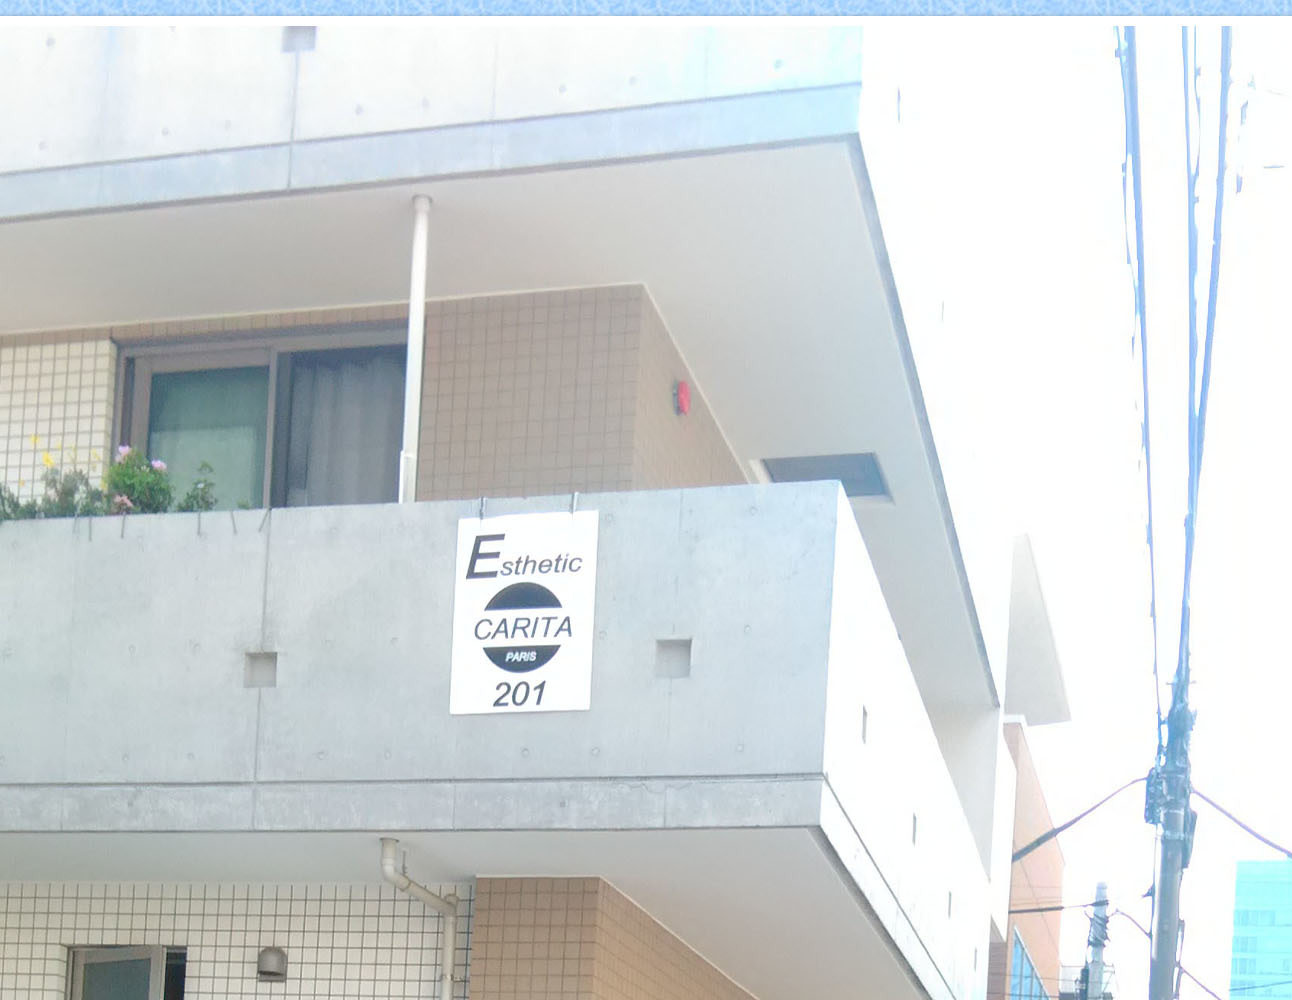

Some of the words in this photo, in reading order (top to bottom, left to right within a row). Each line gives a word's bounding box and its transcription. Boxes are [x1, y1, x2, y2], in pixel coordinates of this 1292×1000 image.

[466, 533, 583, 579] Esthetic
[474, 616, 573, 640] CARITA
[505, 651, 537, 662] PARIS
[493, 680, 547, 707] 201
